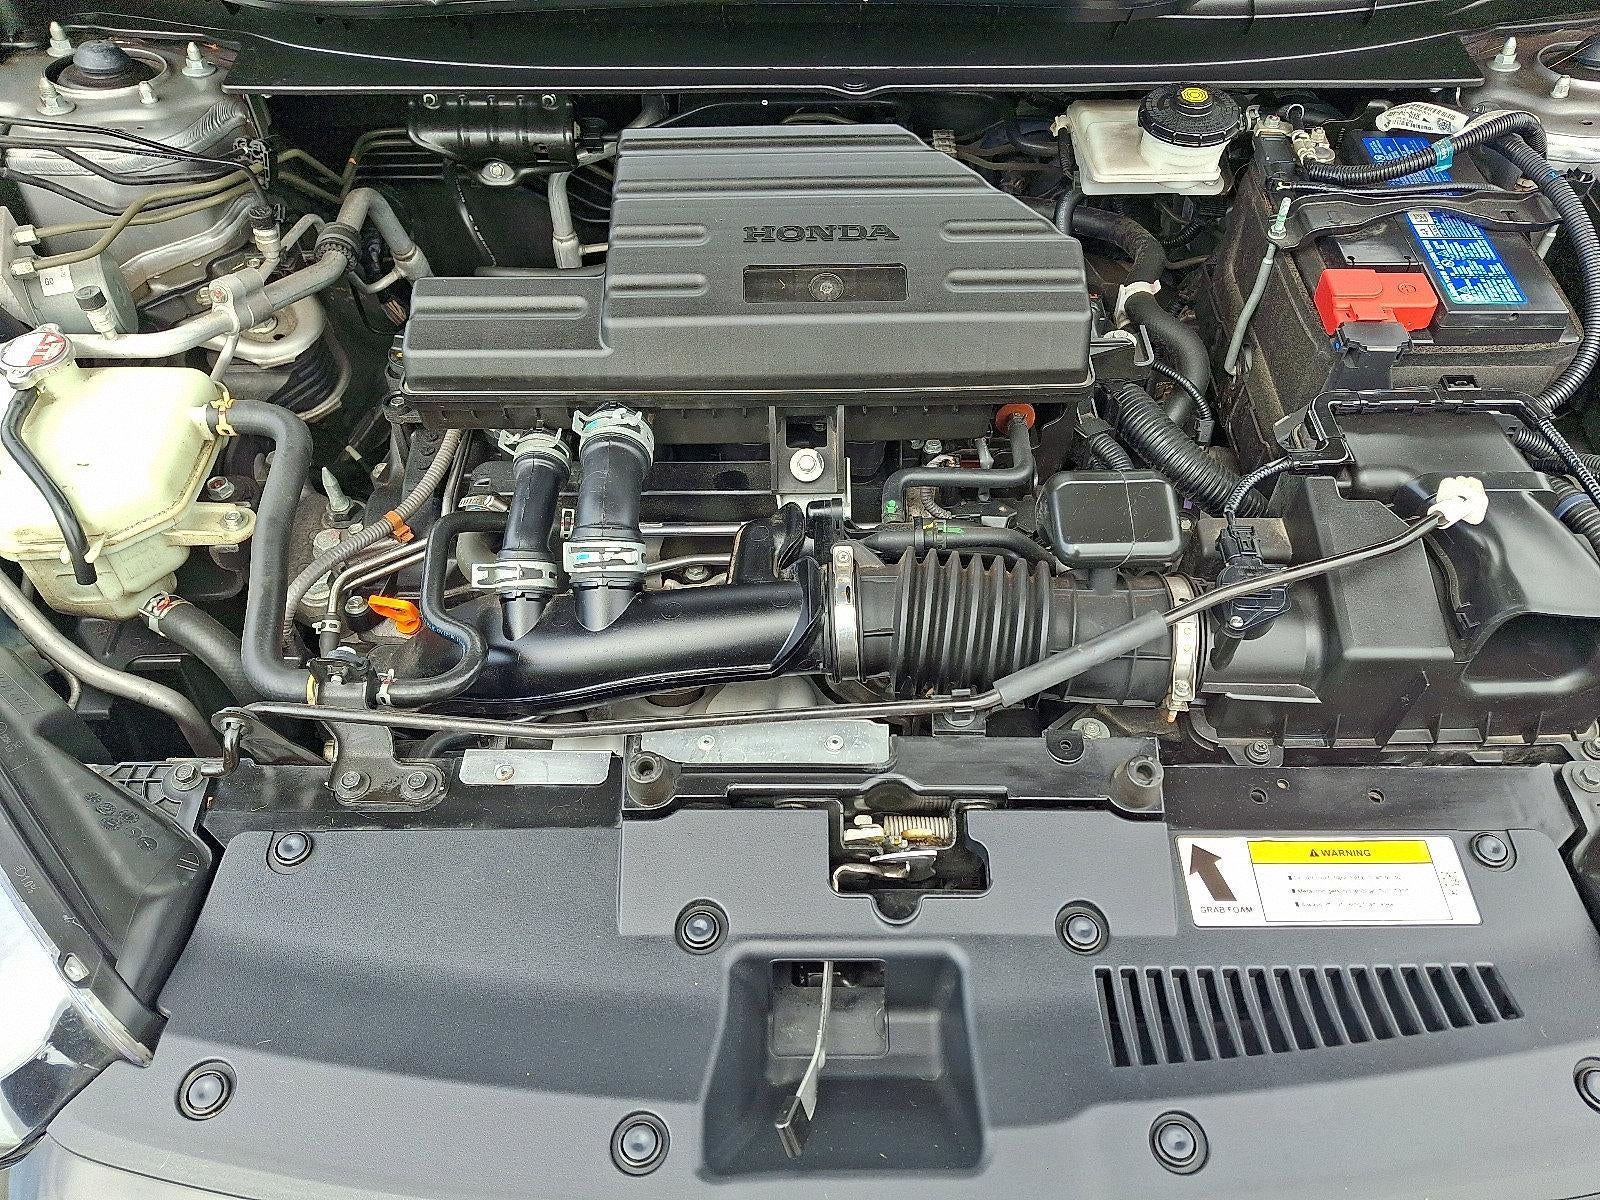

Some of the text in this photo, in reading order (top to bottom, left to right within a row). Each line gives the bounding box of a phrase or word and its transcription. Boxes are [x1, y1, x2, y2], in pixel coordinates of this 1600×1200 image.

[743, 224, 900, 242] HONDA
[1320, 848, 1372, 858] WARNING
[1200, 906, 1254, 914] GRAB FOAM
